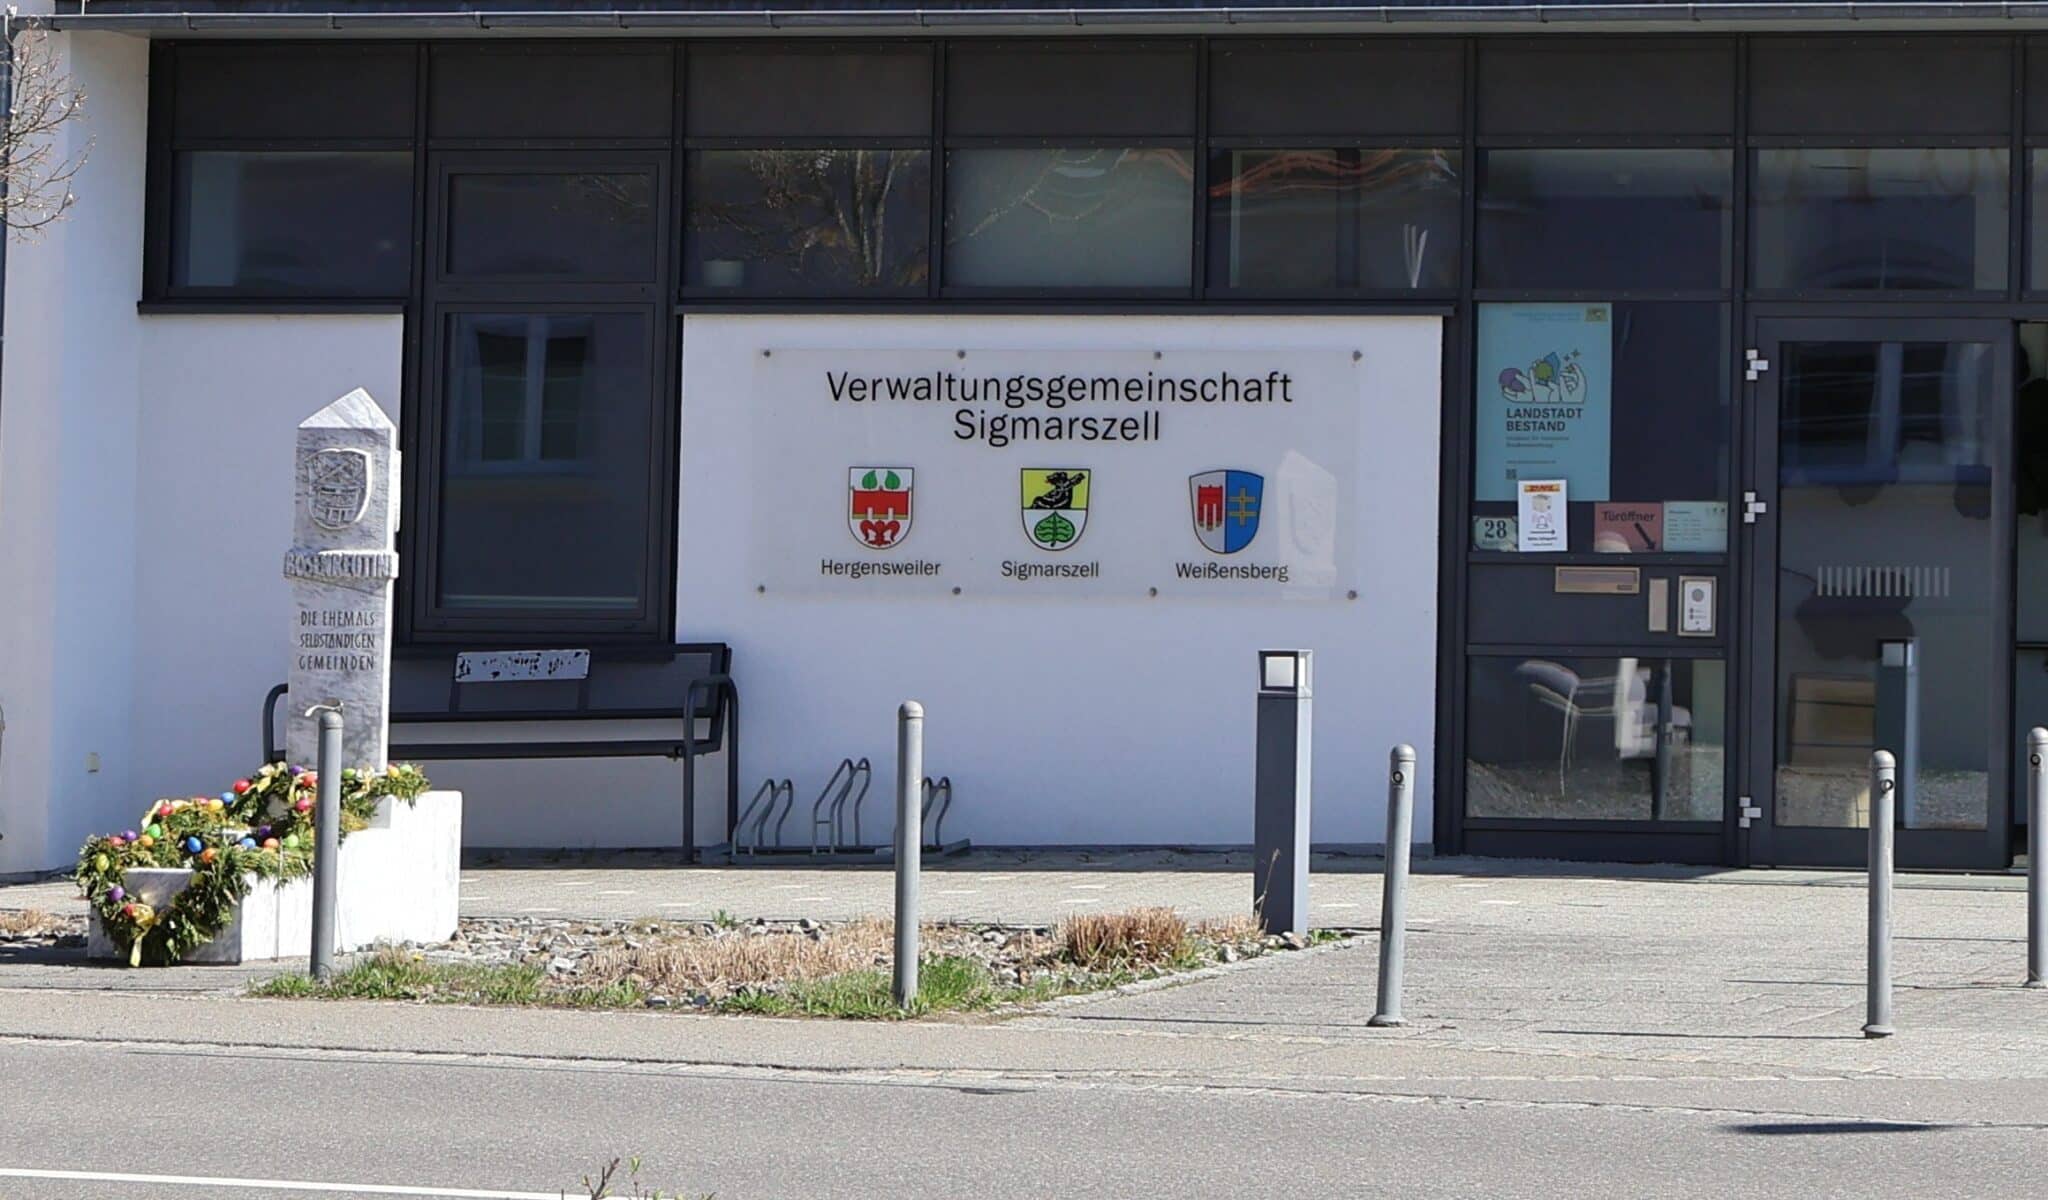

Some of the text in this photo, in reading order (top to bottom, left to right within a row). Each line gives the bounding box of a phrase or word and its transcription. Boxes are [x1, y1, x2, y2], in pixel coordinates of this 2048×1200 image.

[826, 371, 1293, 408] Verwaltungsgemeinschaft
[1506, 407, 1583, 419] LANDSTADT
[953, 409, 1160, 447] Sigmarszell
[1506, 420, 1566, 432] BESTAND
[1602, 511, 1656, 522] Türöffner
[1484, 520, 1507, 539] 28
[821, 559, 941, 579] Hergensweiler
[1001, 560, 1099, 580] Sigmarszell
[1175, 561, 1289, 582] Weißensberg
[300, 611, 375, 627] DIE EHEMALS
[299, 655, 375, 671] GEMEINDEN
